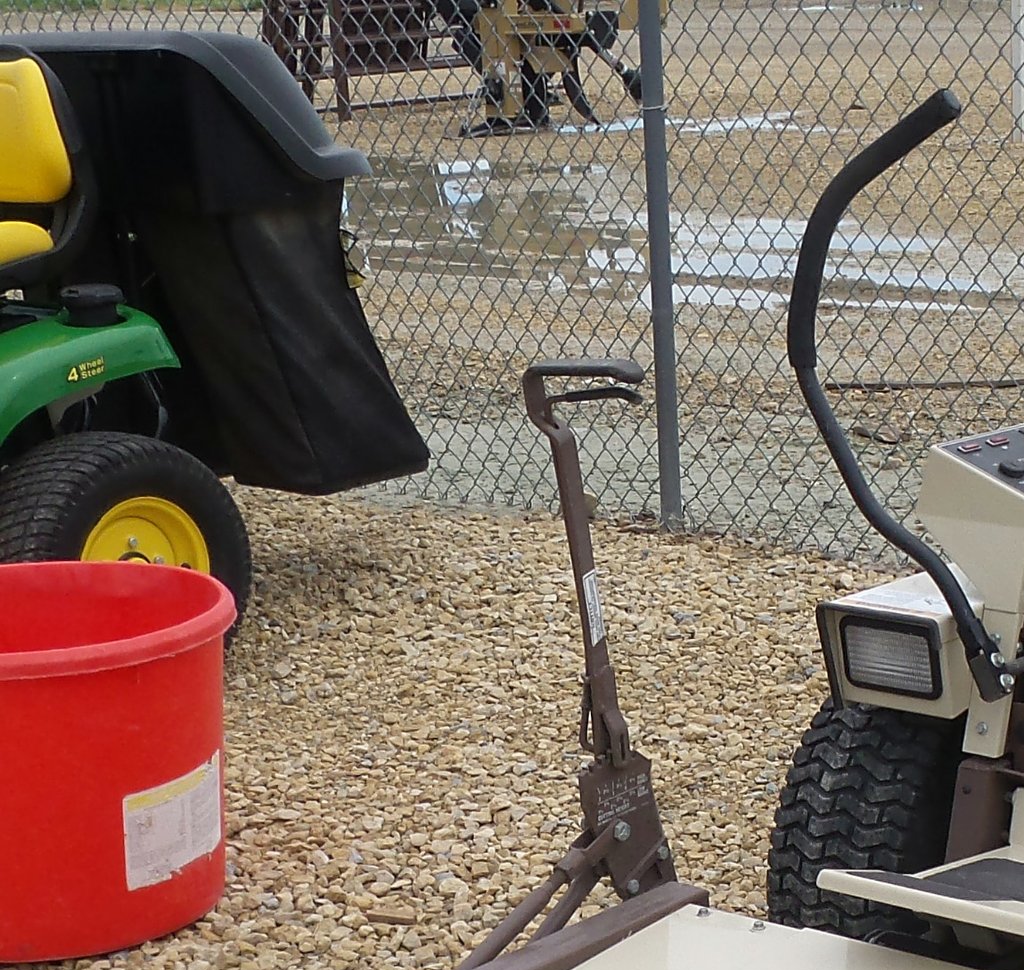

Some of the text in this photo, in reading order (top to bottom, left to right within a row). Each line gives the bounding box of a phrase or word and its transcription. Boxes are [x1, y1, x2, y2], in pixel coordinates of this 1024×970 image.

[79, 356, 104, 371] Wheel
[67, 367, 79, 381] 4
[81, 366, 104, 379] Steer
